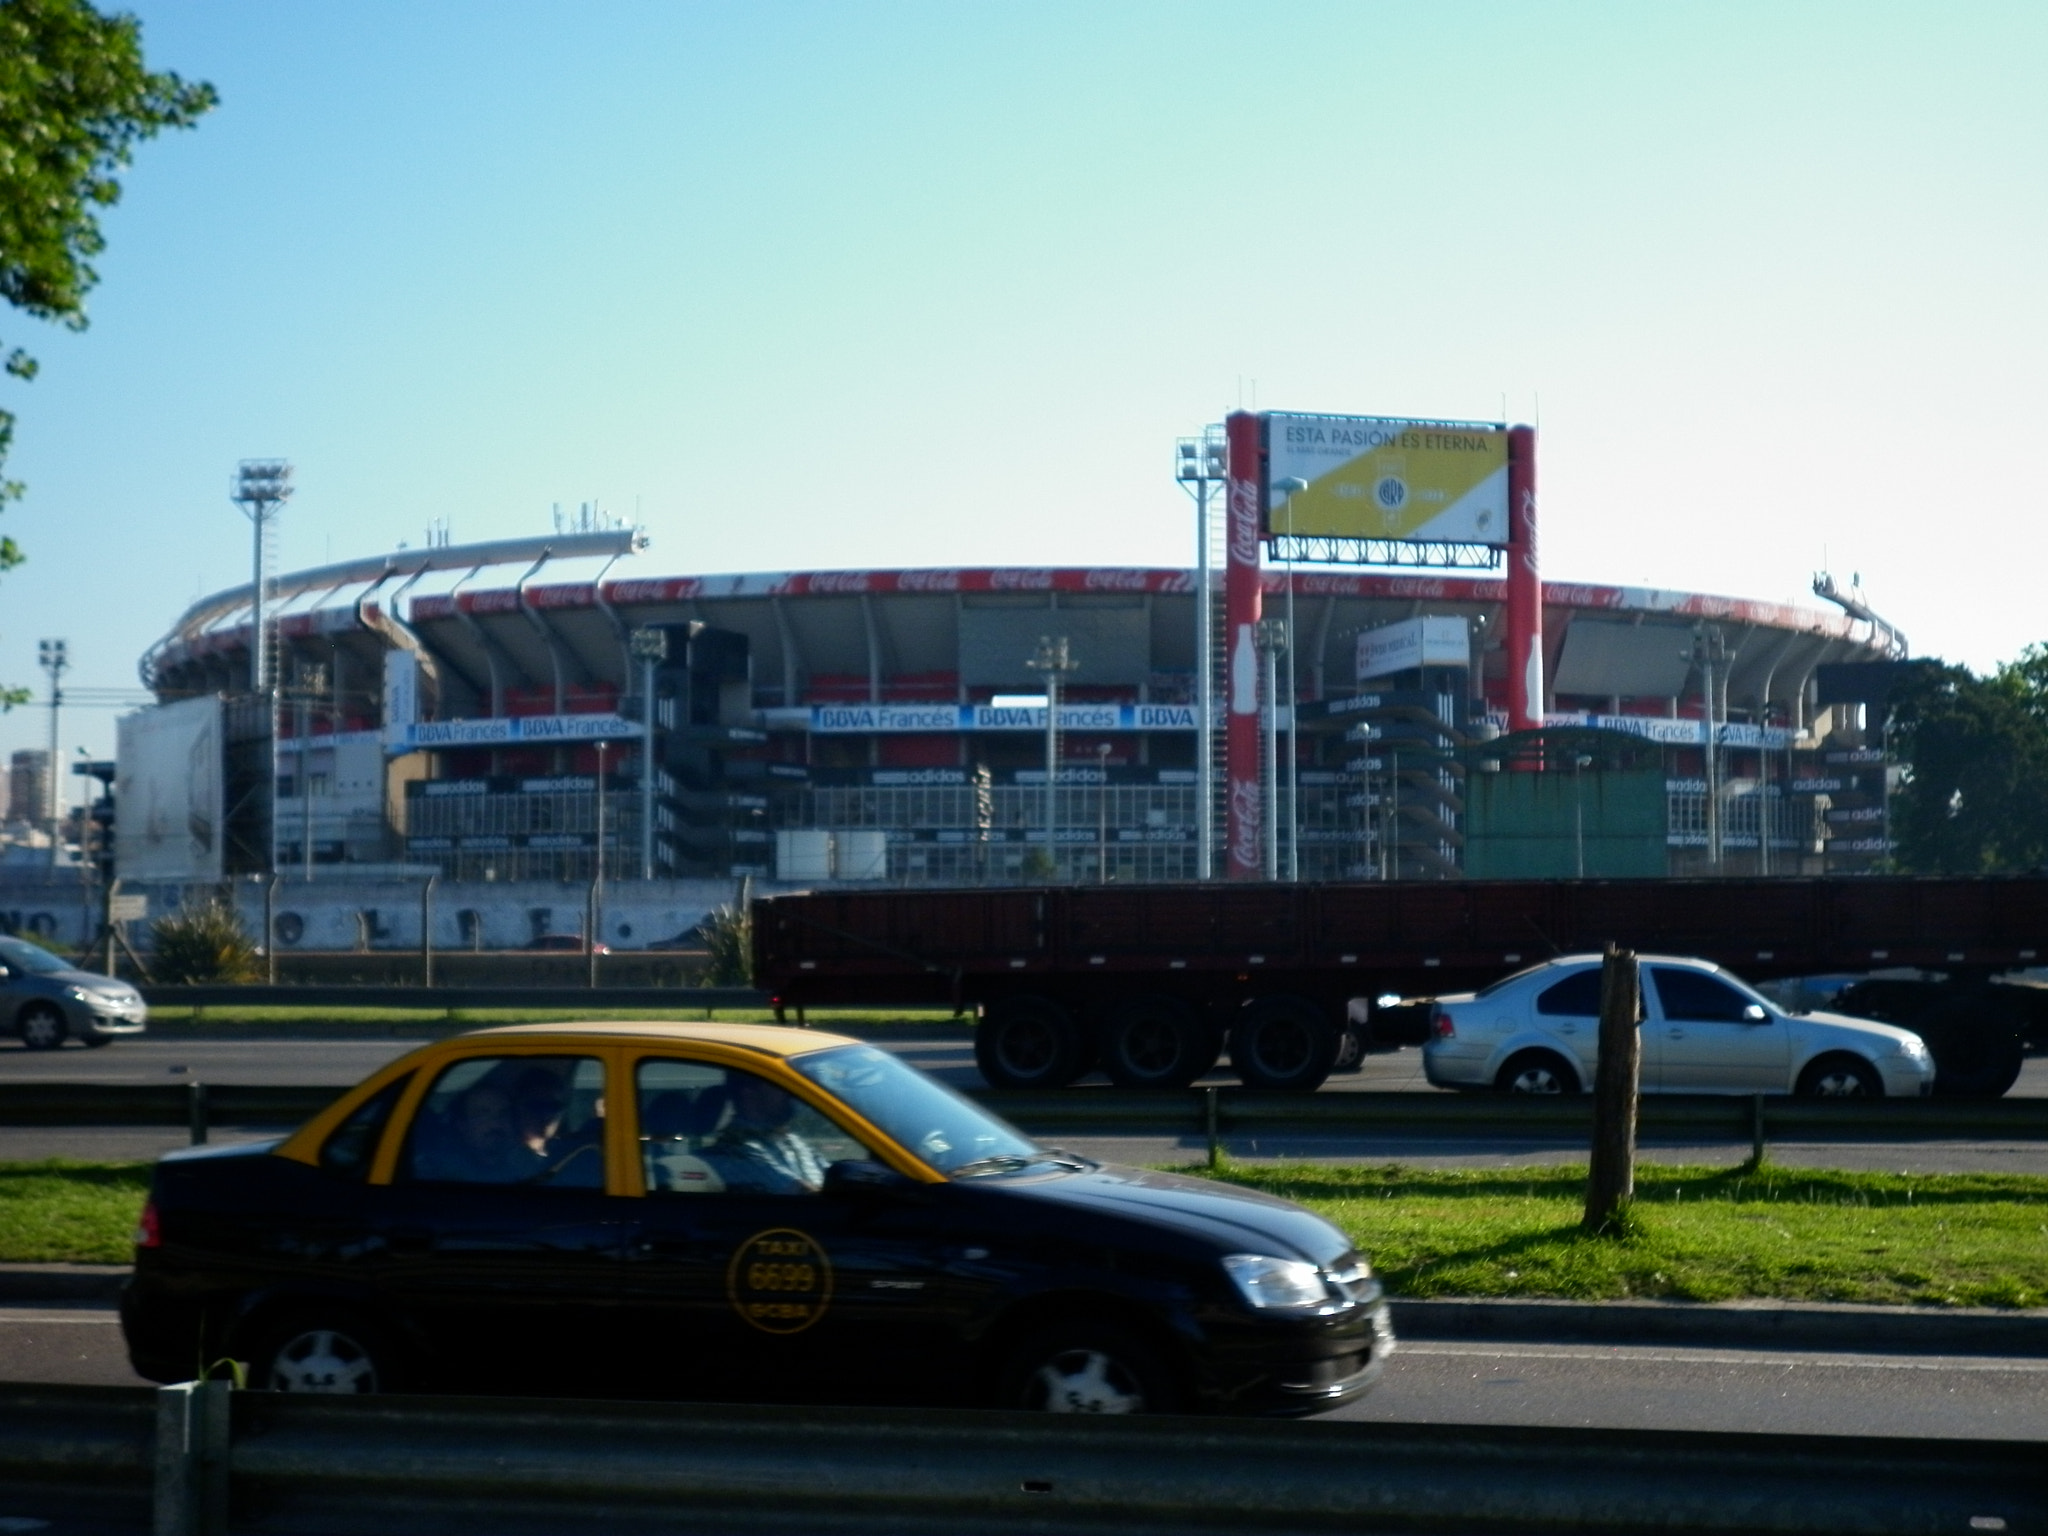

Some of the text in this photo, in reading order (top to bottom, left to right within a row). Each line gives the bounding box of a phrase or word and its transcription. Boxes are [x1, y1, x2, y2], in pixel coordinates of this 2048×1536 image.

[1286, 426, 1326, 443] ESTA
[1401, 432, 1420, 448] ES
[823, 707, 955, 728] BBVA Francés
[979, 707, 1114, 728] BBVA Fancés
[1141, 708, 1194, 726] BBVA
[418, 725, 449, 742] BBVA
[523, 719, 562, 736] BBVA
[906, 768, 965, 784] adidas
[1793, 778, 1841, 791] adidas
[756, 1241, 809, 1255] TAXI
